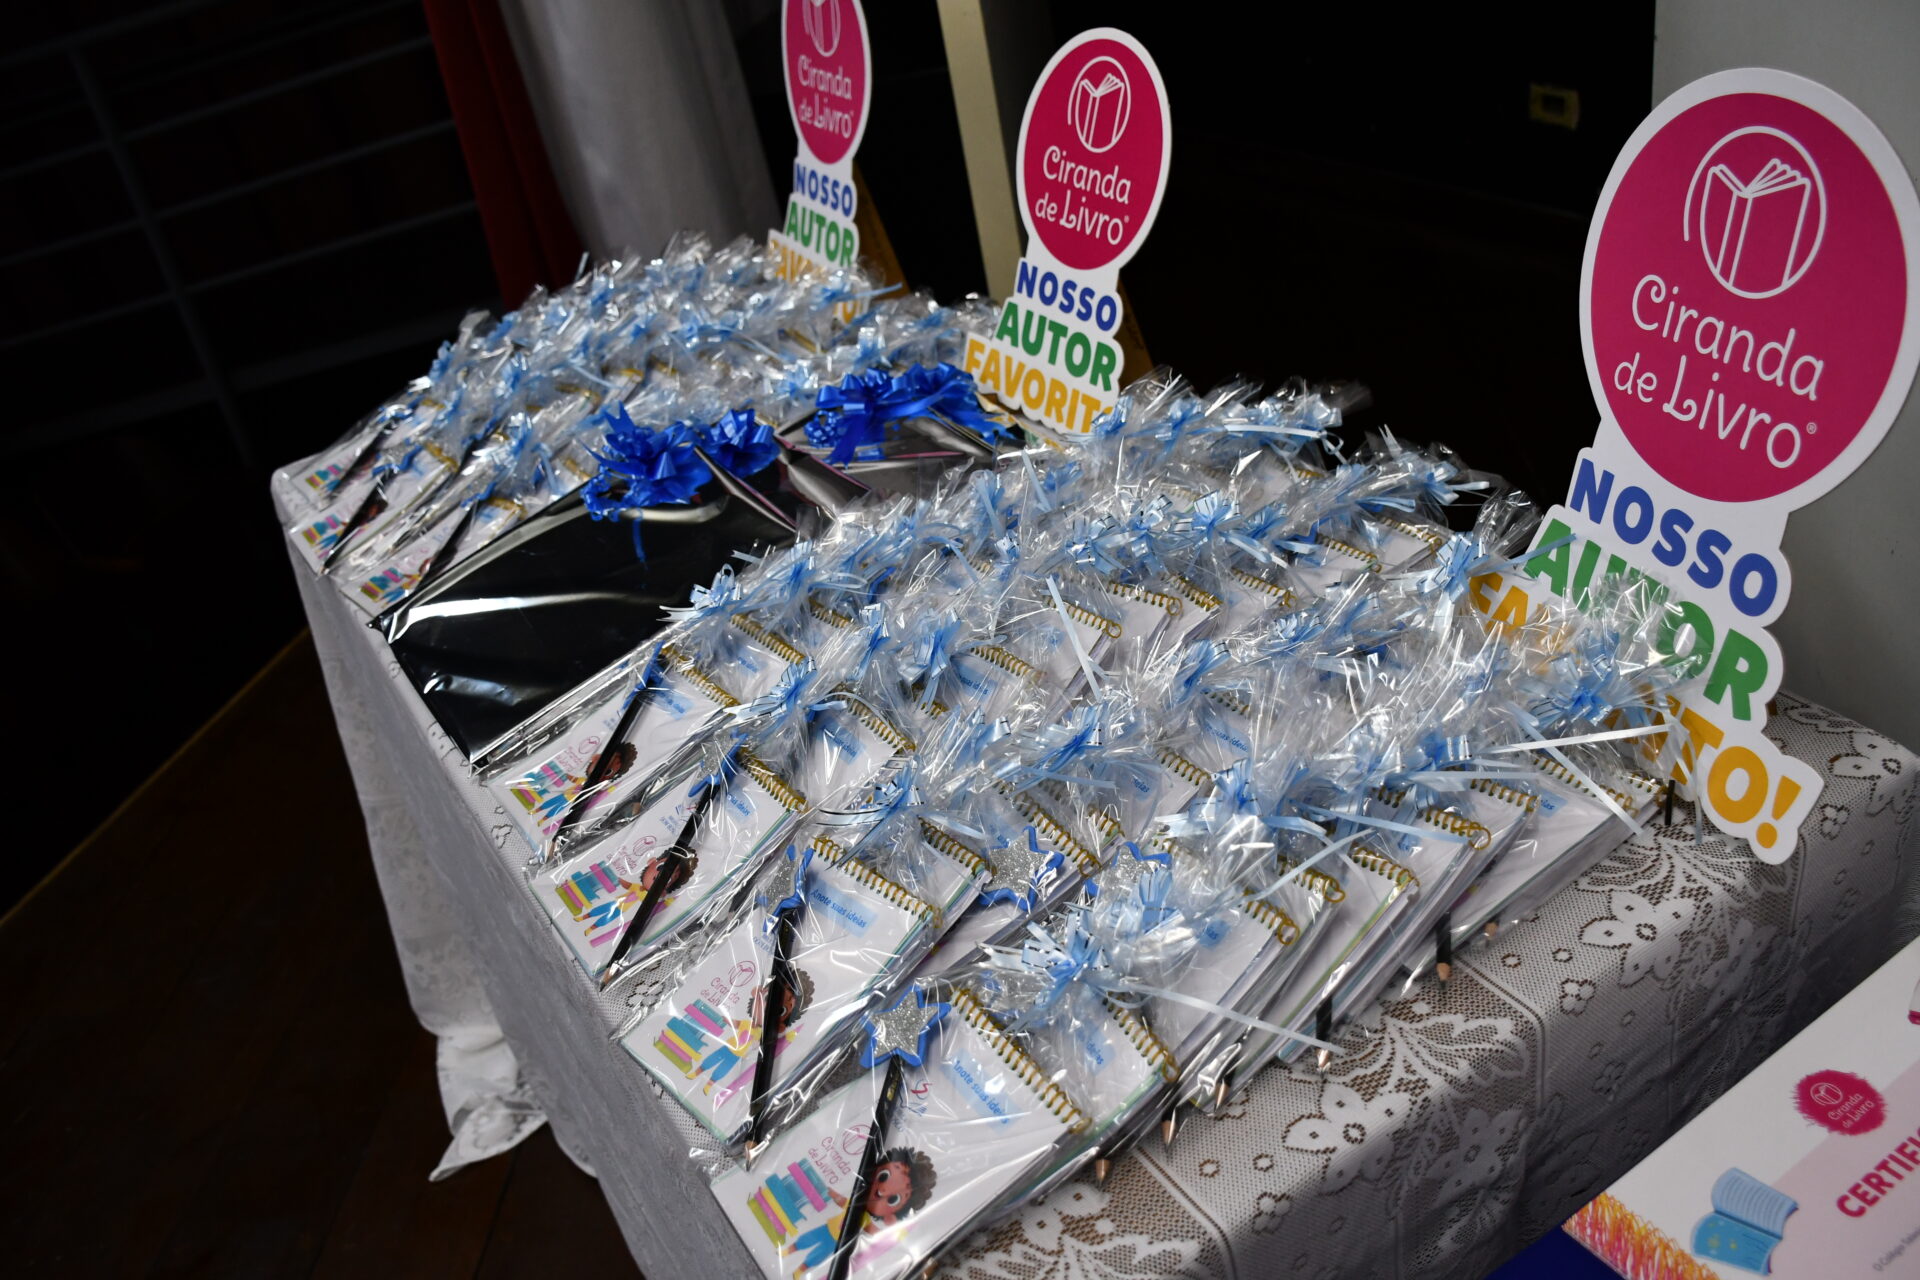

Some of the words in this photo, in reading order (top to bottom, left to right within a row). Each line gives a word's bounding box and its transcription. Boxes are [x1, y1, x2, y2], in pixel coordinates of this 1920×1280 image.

[798, 55, 852, 100] Ciranda
[799, 97, 813, 124] de
[796, 163, 853, 217] NOSSO
[1043, 145, 1131, 205] Ciranda
[1035, 192, 1058, 222] de
[786, 201, 855, 268] AUTOR
[1017, 261, 1117, 331] NOSSO
[996, 301, 1117, 392] AUTOR
[1632, 274, 1824, 401] Ciranda
[963, 338, 1114, 434] FAVORIT
[1614, 352, 1658, 403] de
[1570, 458, 1778, 617] NOSSO
[831, 902, 847, 916] suas
[846, 911, 867, 929] ideias
[1828, 1093, 1864, 1120] Ciranda
[1846, 1100, 1875, 1122] Livro
[808, 1148, 819, 1160] de
[815, 1154, 839, 1185] Livro
[821, 1136, 852, 1176] Ciranda
